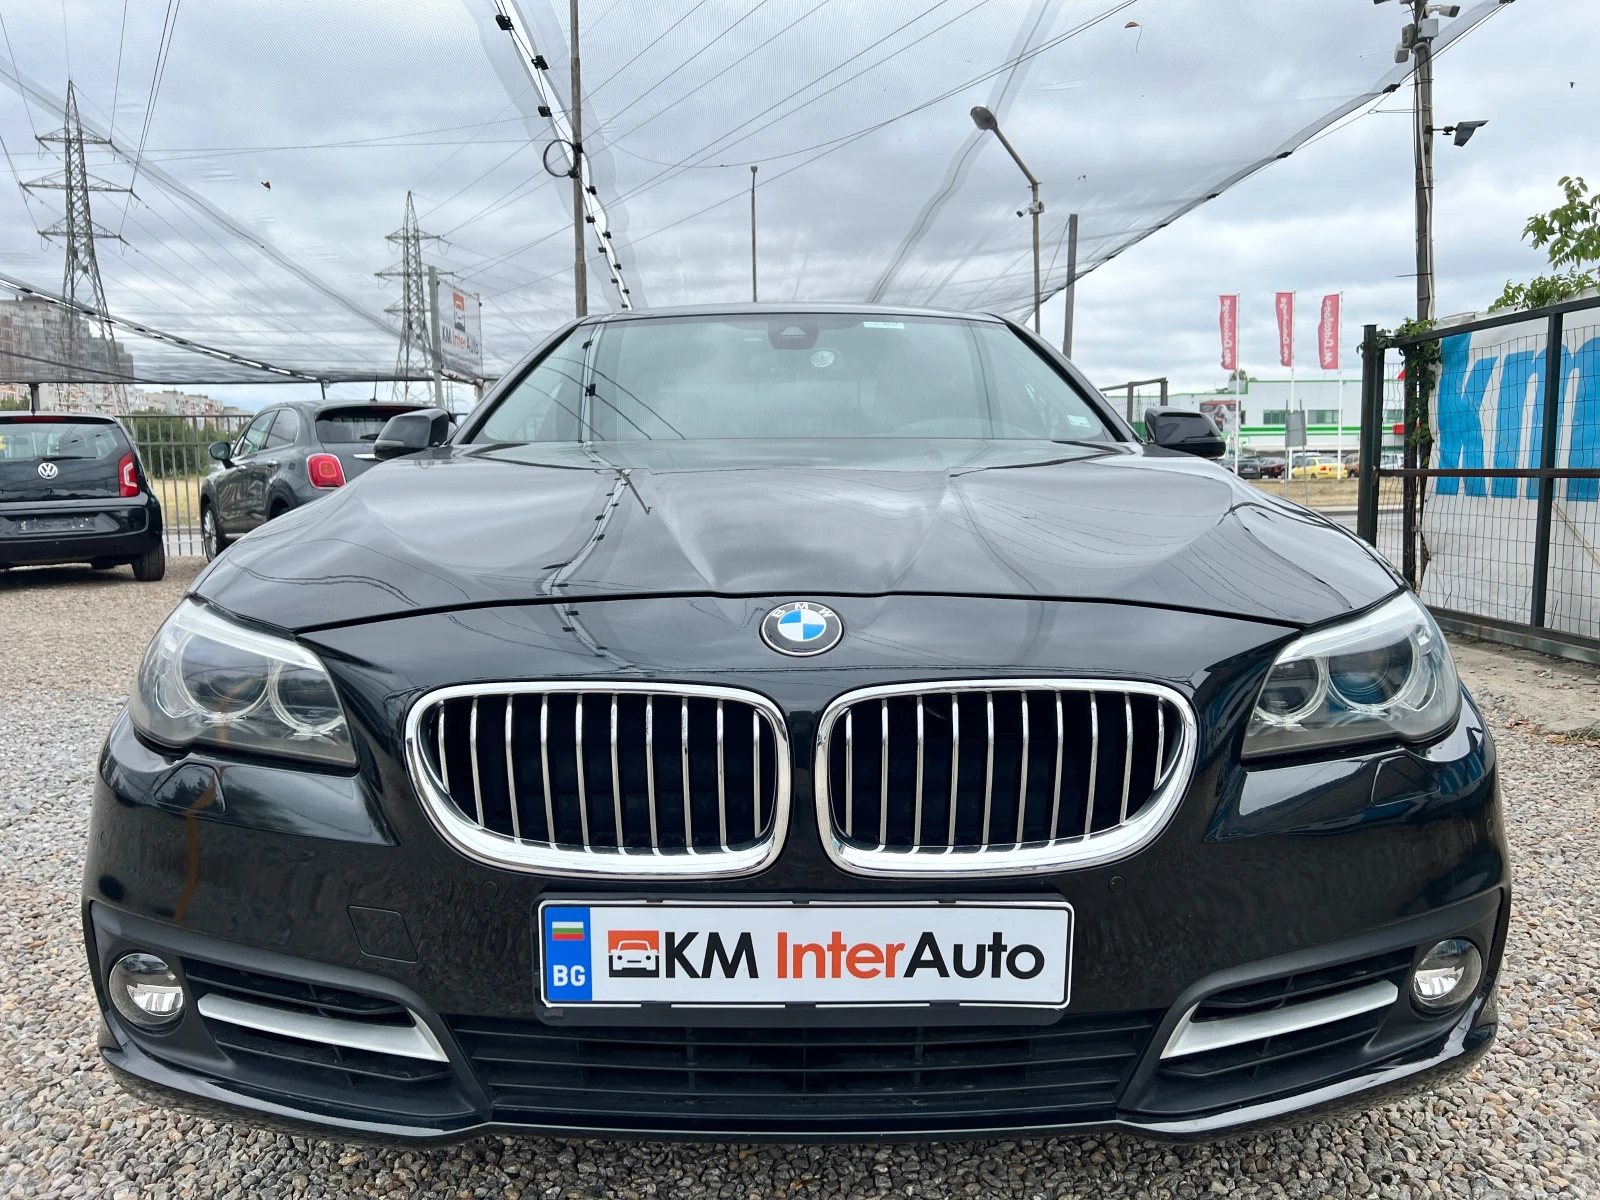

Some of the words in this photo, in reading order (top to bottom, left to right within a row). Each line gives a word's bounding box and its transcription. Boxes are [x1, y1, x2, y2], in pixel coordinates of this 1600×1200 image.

[770, 602, 835, 618] BMW
[664, 931, 759, 979] KM
[777, 931, 1045, 980] InterAuto
[552, 964, 586, 987] BG
